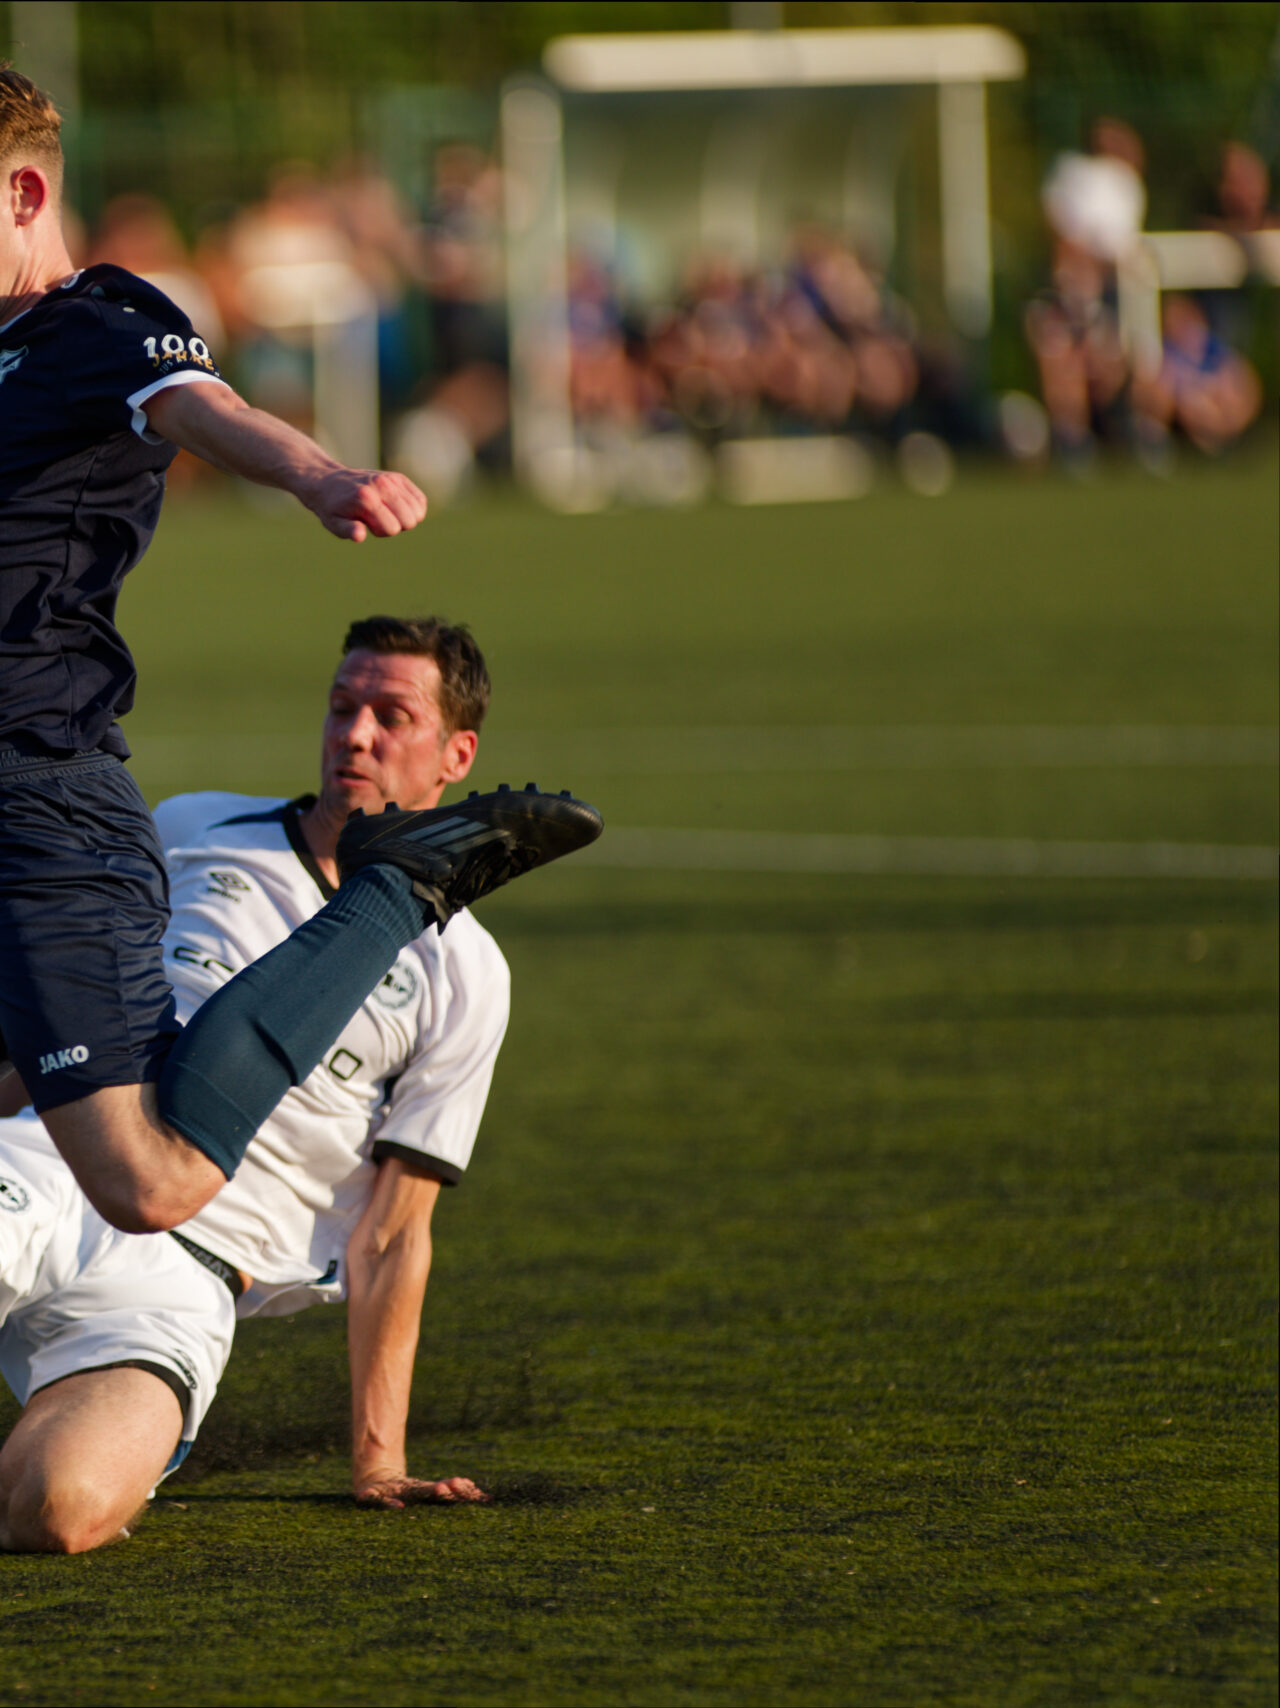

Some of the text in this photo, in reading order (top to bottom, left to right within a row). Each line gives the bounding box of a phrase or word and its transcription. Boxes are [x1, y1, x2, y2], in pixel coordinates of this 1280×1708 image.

[143, 334, 209, 360] 100
[152, 351, 214, 370] JAHRE
[39, 1045, 89, 1074] JAKO
